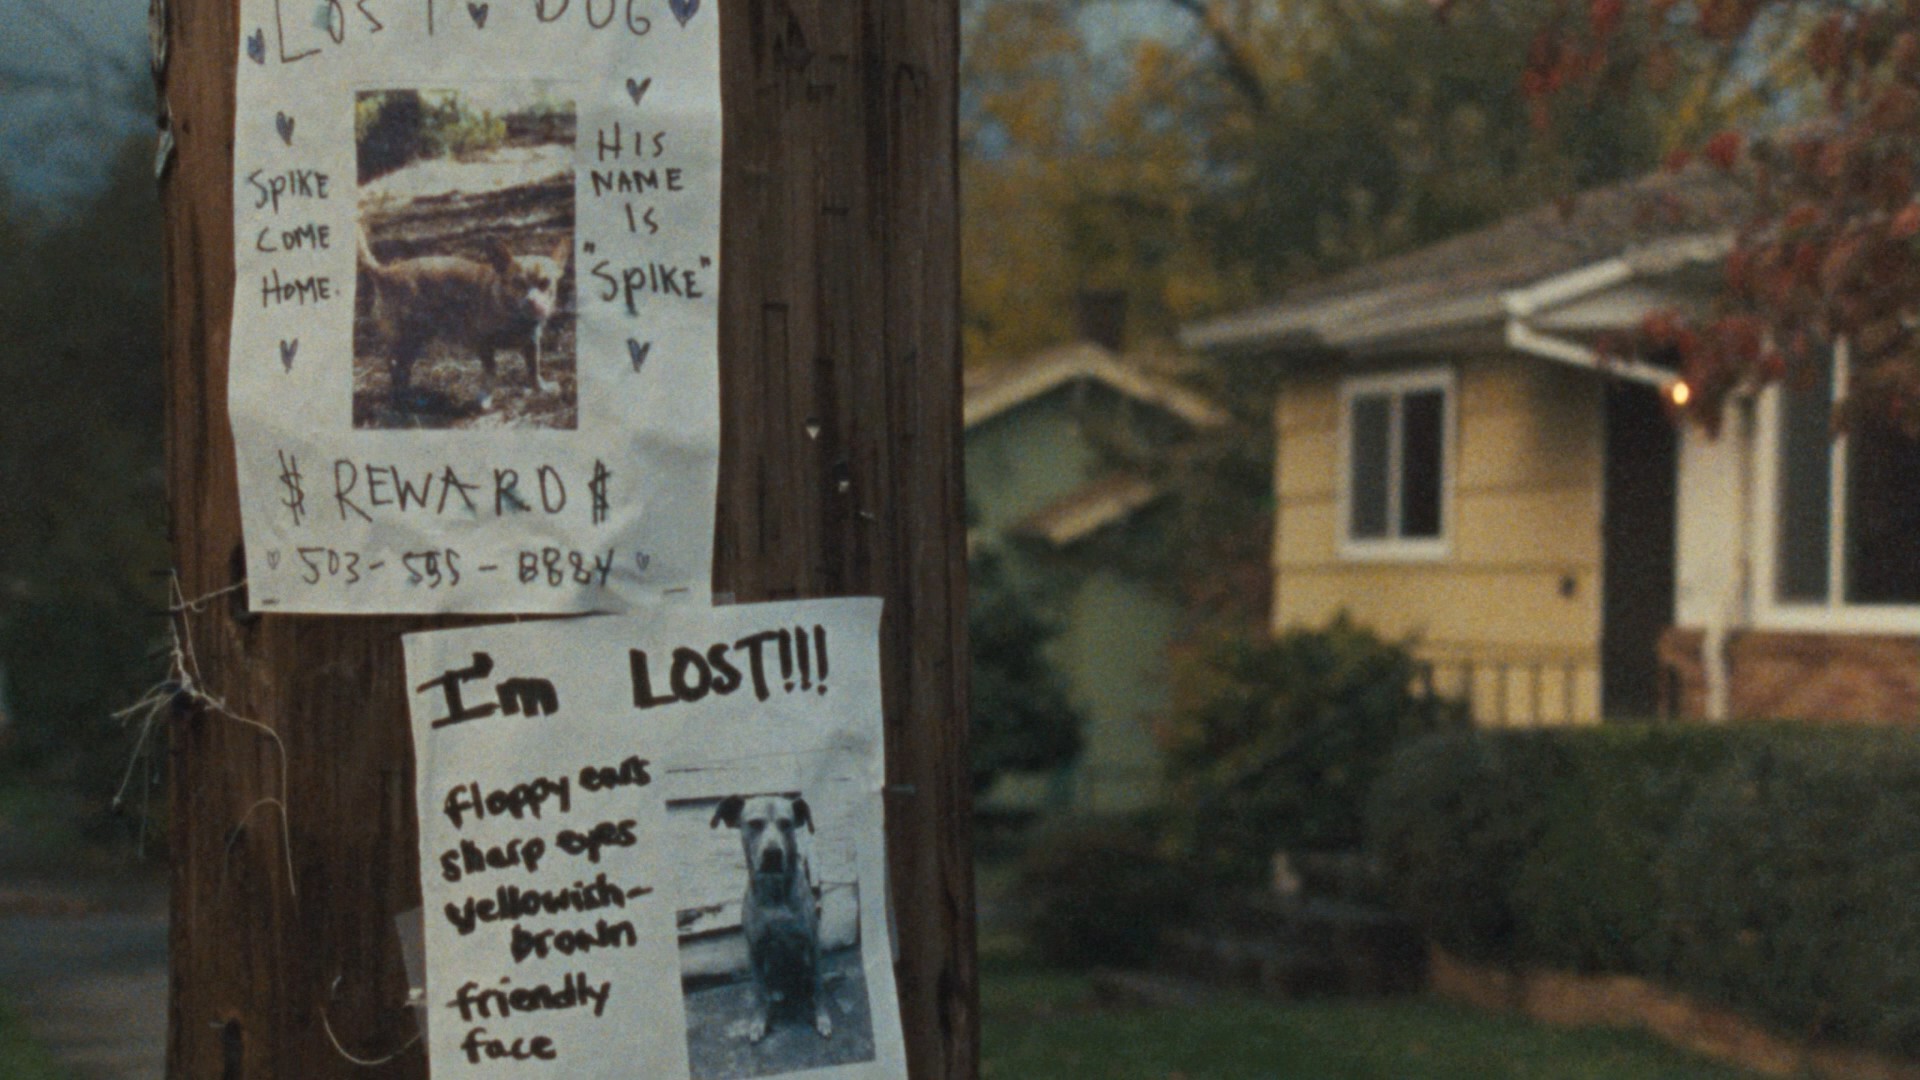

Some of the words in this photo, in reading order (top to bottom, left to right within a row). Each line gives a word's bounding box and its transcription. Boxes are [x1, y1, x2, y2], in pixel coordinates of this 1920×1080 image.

[598, 122, 666, 162] HIS
[591, 168, 684, 197] NAME
[256, 223, 330, 253] COME
[625, 203, 659, 234] IS
[262, 268, 340, 308] HOME.
[333, 459, 567, 522] REWARD
[630, 624, 829, 709] LOST!!!
[444, 776, 571, 830] floppy
[440, 837, 546, 882] sharp
[510, 918, 637, 964] brown
[446, 971, 611, 1022] friendly
[461, 1026, 557, 1064] face
